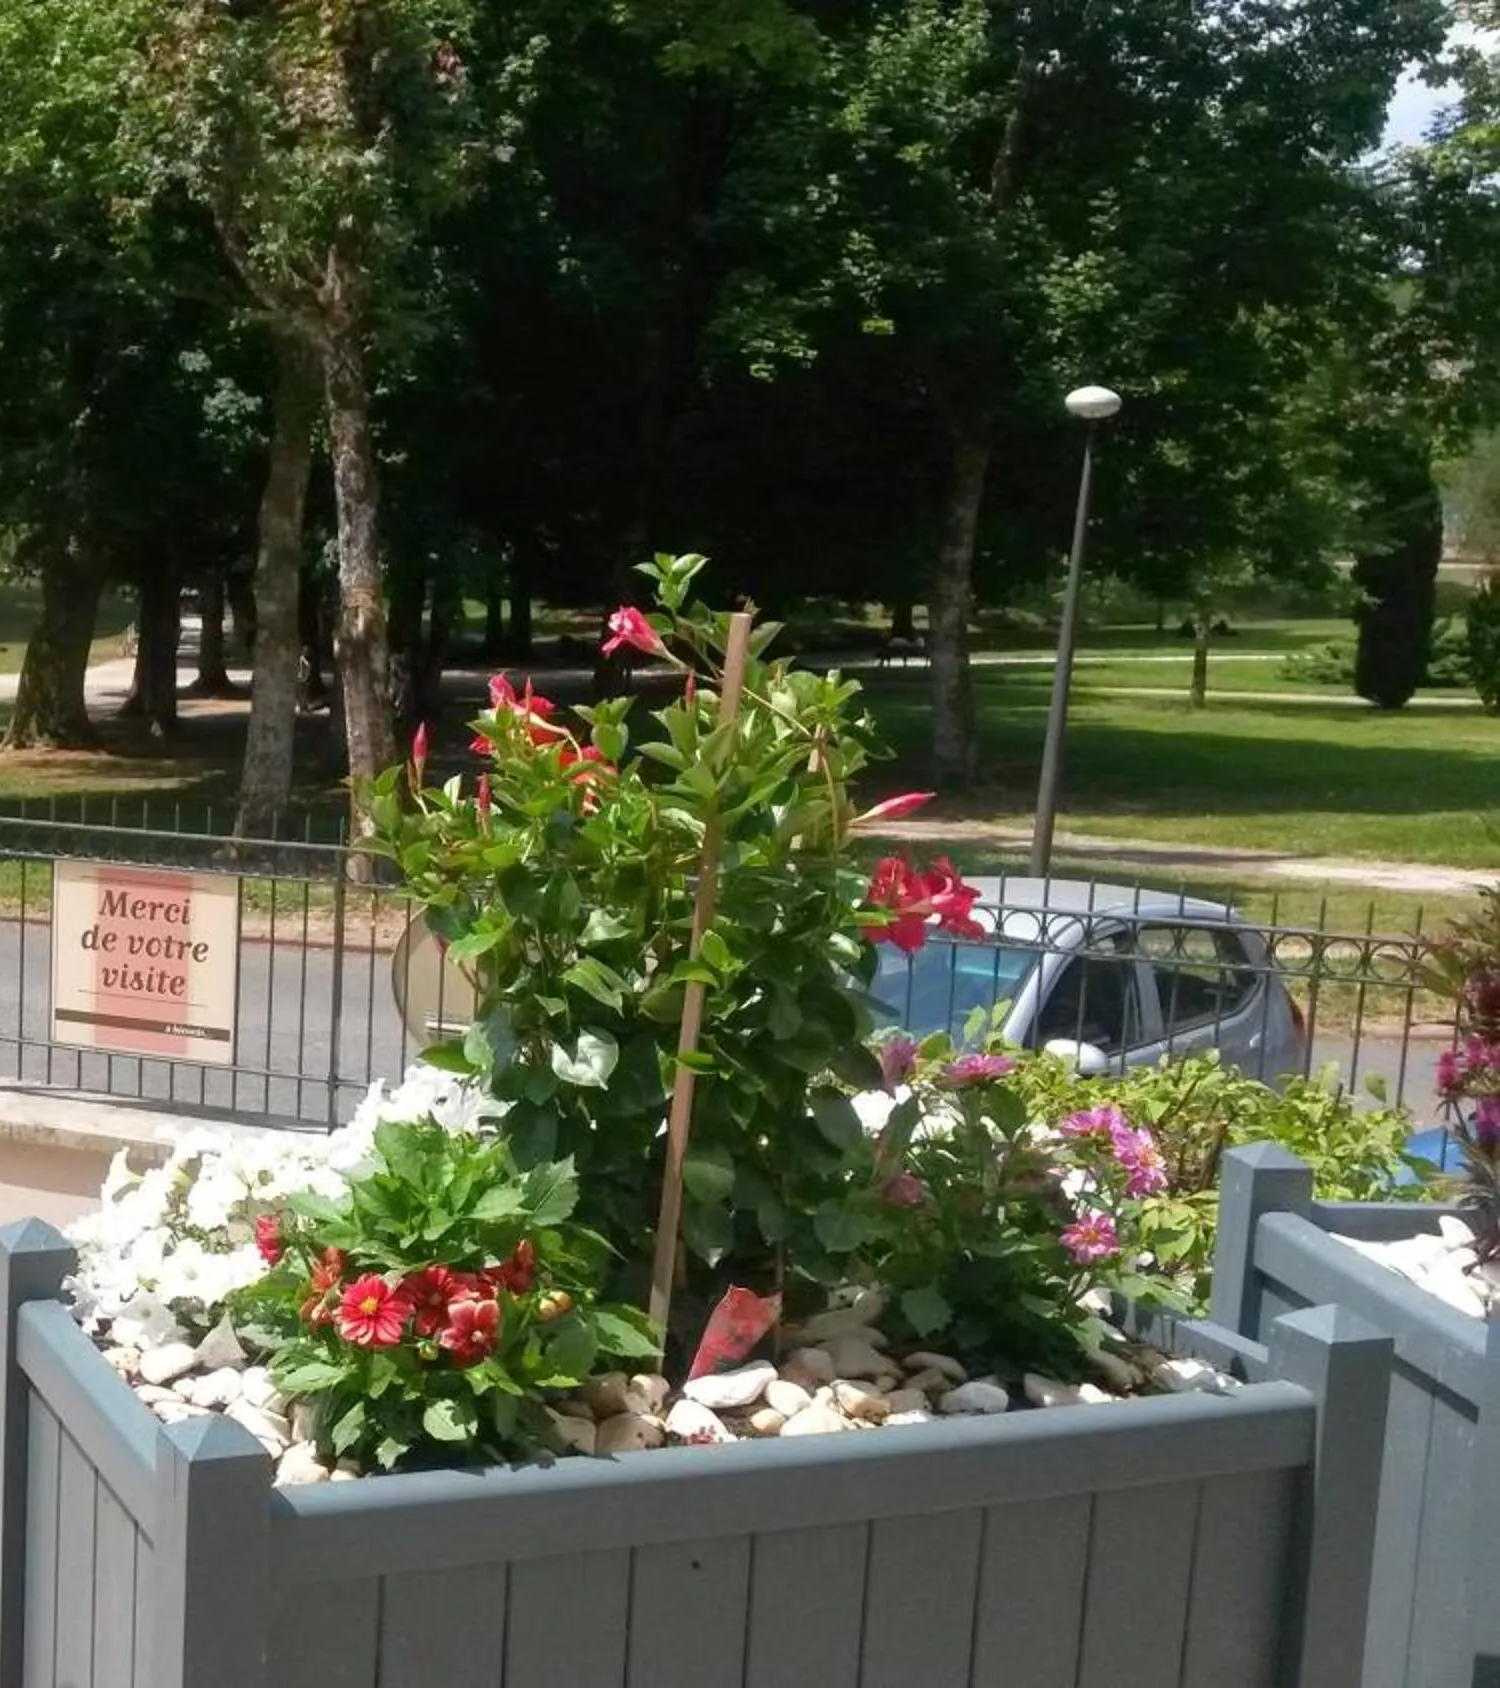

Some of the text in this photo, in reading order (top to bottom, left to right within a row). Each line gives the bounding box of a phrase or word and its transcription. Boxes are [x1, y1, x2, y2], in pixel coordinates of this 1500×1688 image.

[99, 889, 192, 924] Merci
[81, 923, 209, 963] de votre
[102, 963, 186, 997] visite
